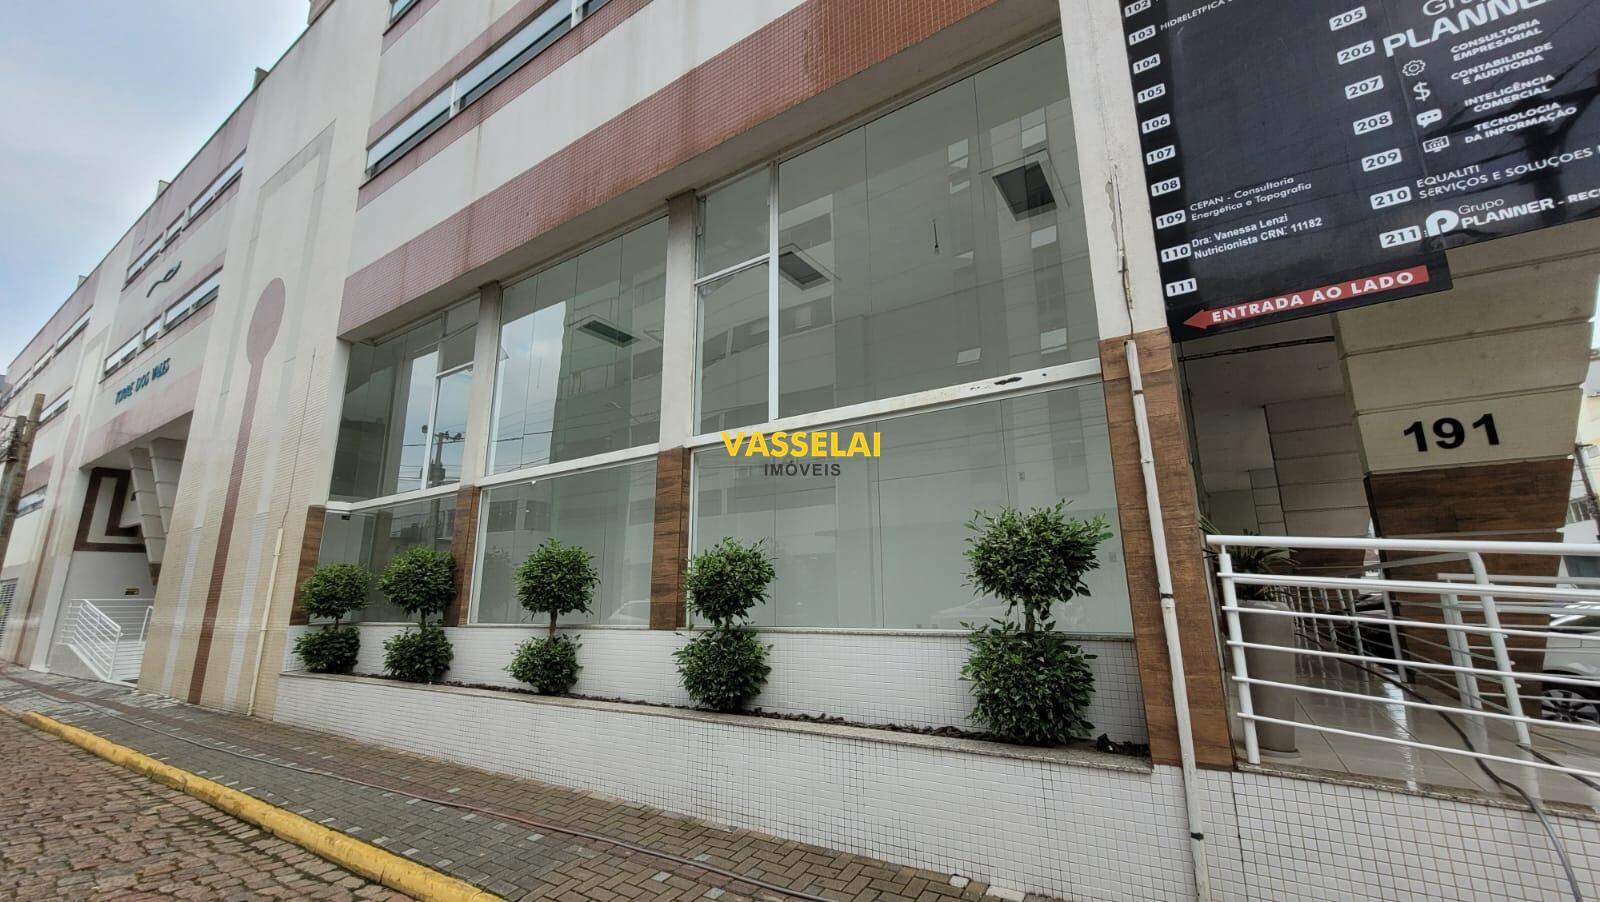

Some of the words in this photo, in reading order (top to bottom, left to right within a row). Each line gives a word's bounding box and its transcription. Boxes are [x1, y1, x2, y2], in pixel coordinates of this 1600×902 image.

[1127, 0, 1149, 15] 102
[1333, 10, 1364, 28] 205
[1131, 27, 1154, 43] 103
[1450, 18, 1540, 54] CONSULTORIA
[1340, 44, 1372, 62] 206
[1453, 27, 1543, 62] EMPRESARIAL
[1135, 57, 1158, 72] 104
[1451, 41, 1553, 80] CONTABILIDADE
[1462, 77, 1471, 85] E
[1474, 54, 1544, 82] AUDITORIA
[1140, 86, 1163, 100] 105
[1348, 79, 1380, 96] 207
[1464, 73, 1555, 107] INTELIGÊNCIA
[1473, 84, 1552, 113] COMERCIAL
[1144, 117, 1168, 131] 106
[1356, 115, 1390, 132] 208
[1474, 101, 1561, 131] TECNOLOGIA
[1465, 133, 1482, 144] DA
[1149, 148, 1173, 162] 107
[1365, 152, 1398, 168] 209
[1416, 164, 1481, 188] EQUALITI
[1154, 179, 1178, 194] 108
[1190, 195, 1224, 211] CEPAN
[1234, 176, 1294, 199] Consultoria
[1255, 182, 1312, 203] Topografia
[1418, 174, 1488, 200] SERVIÇOS
[1492, 171, 1501, 181] E
[1374, 190, 1408, 206] 210
[1458, 198, 1505, 215] Grupo
[1461, 197, 1555, 229] PLANNER
[1567, 187, 1600, 203] REC
[1159, 213, 1183, 226] 109
[1214, 223, 1258, 241] Vanessa
[1259, 213, 1288, 229] Lenzi
[1194, 235, 1258, 260] Nutricionista
[1260, 225, 1288, 242] CRN:
[1290, 217, 1323, 233] 11182
[1383, 229, 1419, 245] 211
[1164, 246, 1189, 260] 110
[1169, 281, 1195, 294] 111
[1212, 294, 1303, 323] ENTRADA
[1312, 286, 1342, 303] AO
[1351, 271, 1414, 295] LADO
[1403, 413, 1500, 452] 191
